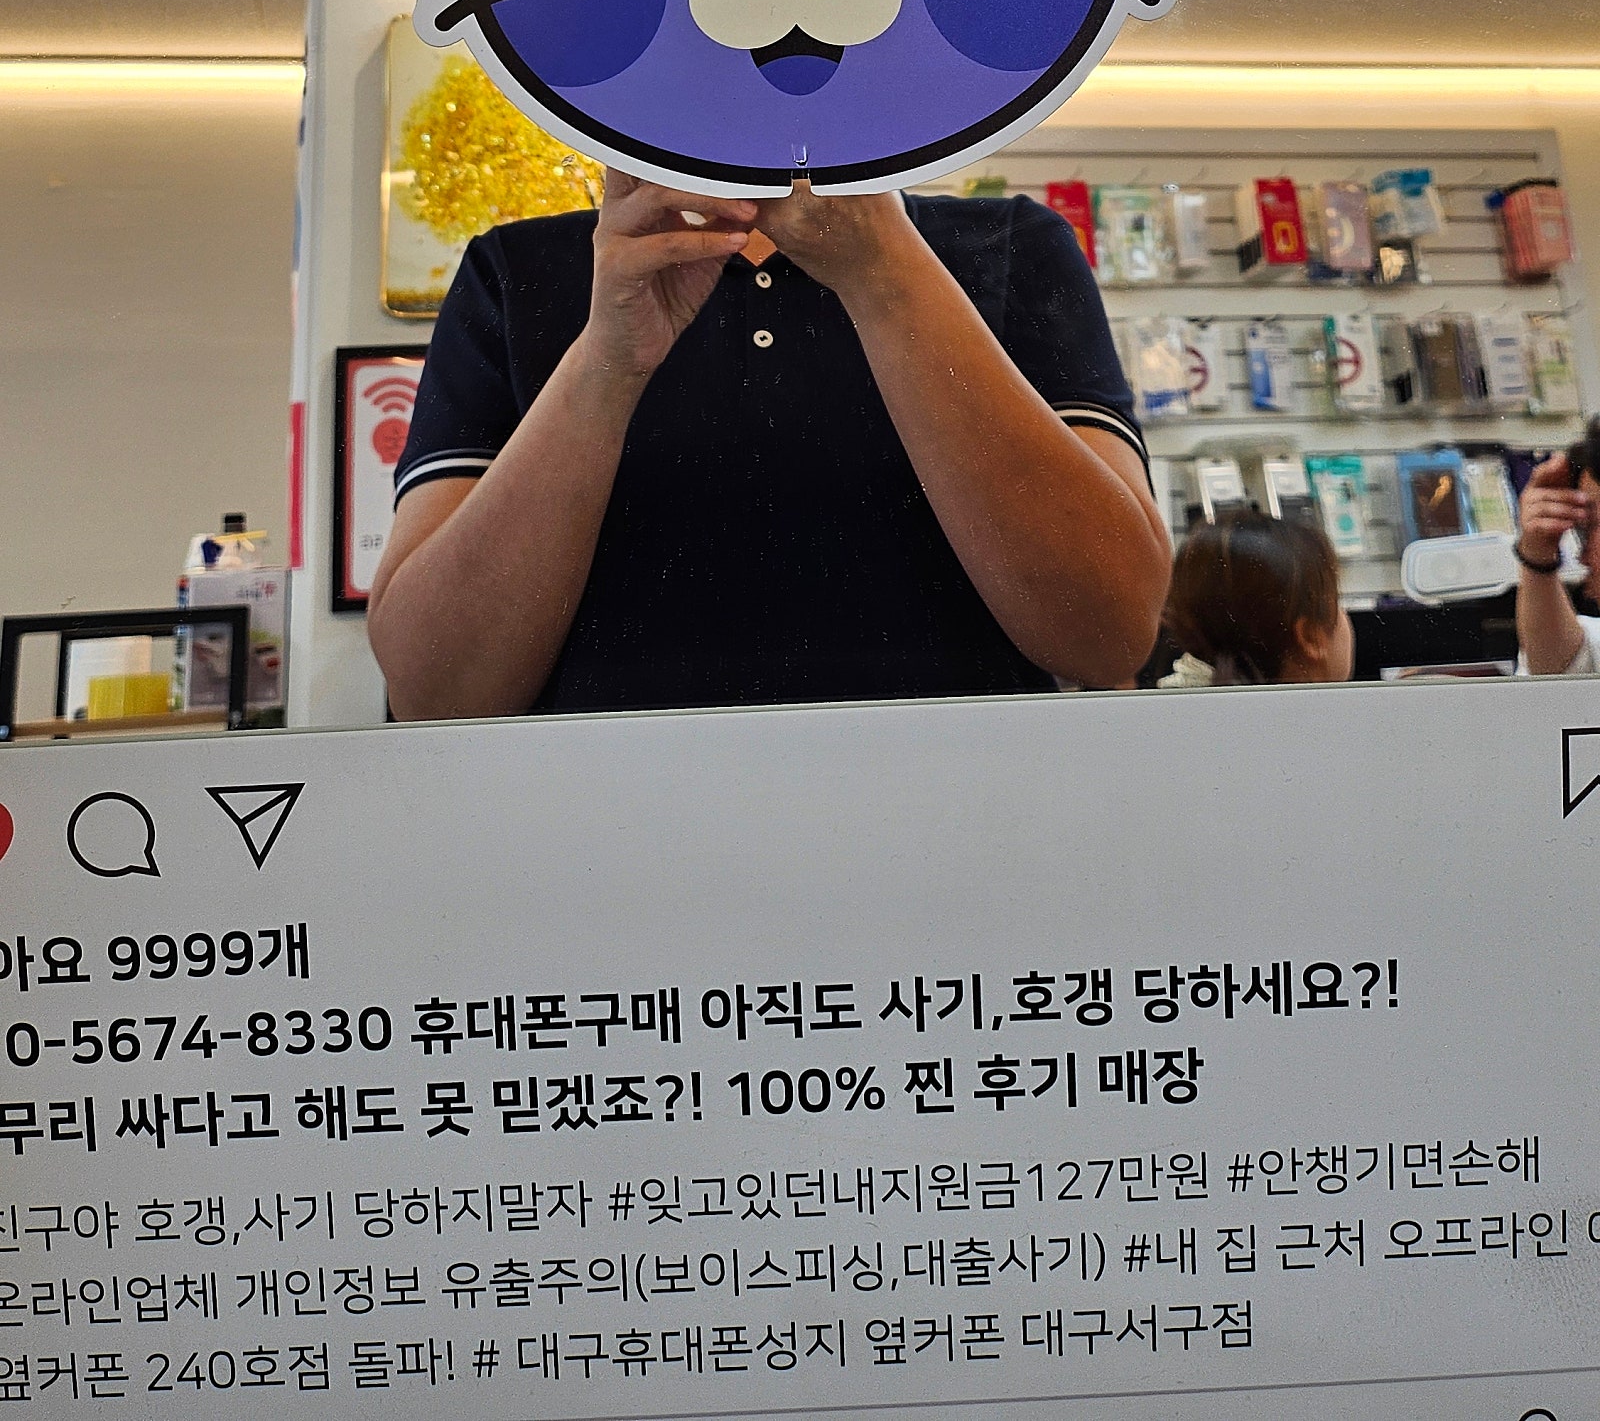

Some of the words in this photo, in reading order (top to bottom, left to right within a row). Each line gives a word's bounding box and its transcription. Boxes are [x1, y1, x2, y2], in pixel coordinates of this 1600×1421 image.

[107, 922, 310, 981] 9999개
[5, 1006, 392, 1067] 0-5674-8330
[410, 986, 682, 1056] 휴대폰구매
[701, 981, 863, 1041] 아직도
[878, 968, 1113, 1033] 사기,호갱
[1134, 958, 1398, 1024] 당하세요?!
[0, 1096, 97, 1156] 무리
[115, 1091, 280, 1149] 싸다고
[294, 1085, 405, 1141] 해도
[420, 1081, 474, 1139] 못
[492, 1071, 703, 1134] 믿겠죠?!
[727, 1066, 886, 1116] 100%
[903, 1057, 955, 1114] 찐
[973, 1052, 1077, 1112] 후기
[1098, 1046, 1205, 1105] 매장
[135, 1191, 335, 1246] 호갱,사기
[354, 1180, 593, 1239] 당하지말자
[607, 1151, 1209, 1225] #잊고있던내지원금127만원
[1226, 1135, 1540, 1196] #안챙기면손해
[0, 1271, 218, 1328] 온라인업체
[236, 1265, 427, 1318] 개인정보
[441, 1232, 1106, 1303] 유출주의(보이스피싱,대출사기)
[1123, 1227, 1197, 1275] #내
[1216, 1224, 1256, 1274] 집
[1275, 1219, 1364, 1271] 근처
[1384, 1209, 1568, 1260] 오프라인
[0, 1352, 130, 1402] 옆커폰
[146, 1342, 330, 1392] 240호점
[348, 1337, 455, 1389] 돌파!
[517, 1319, 846, 1380] 대구휴대폰성지
[865, 1314, 1005, 1365] 옆커폰
[1021, 1299, 1252, 1357] 대구서구점
